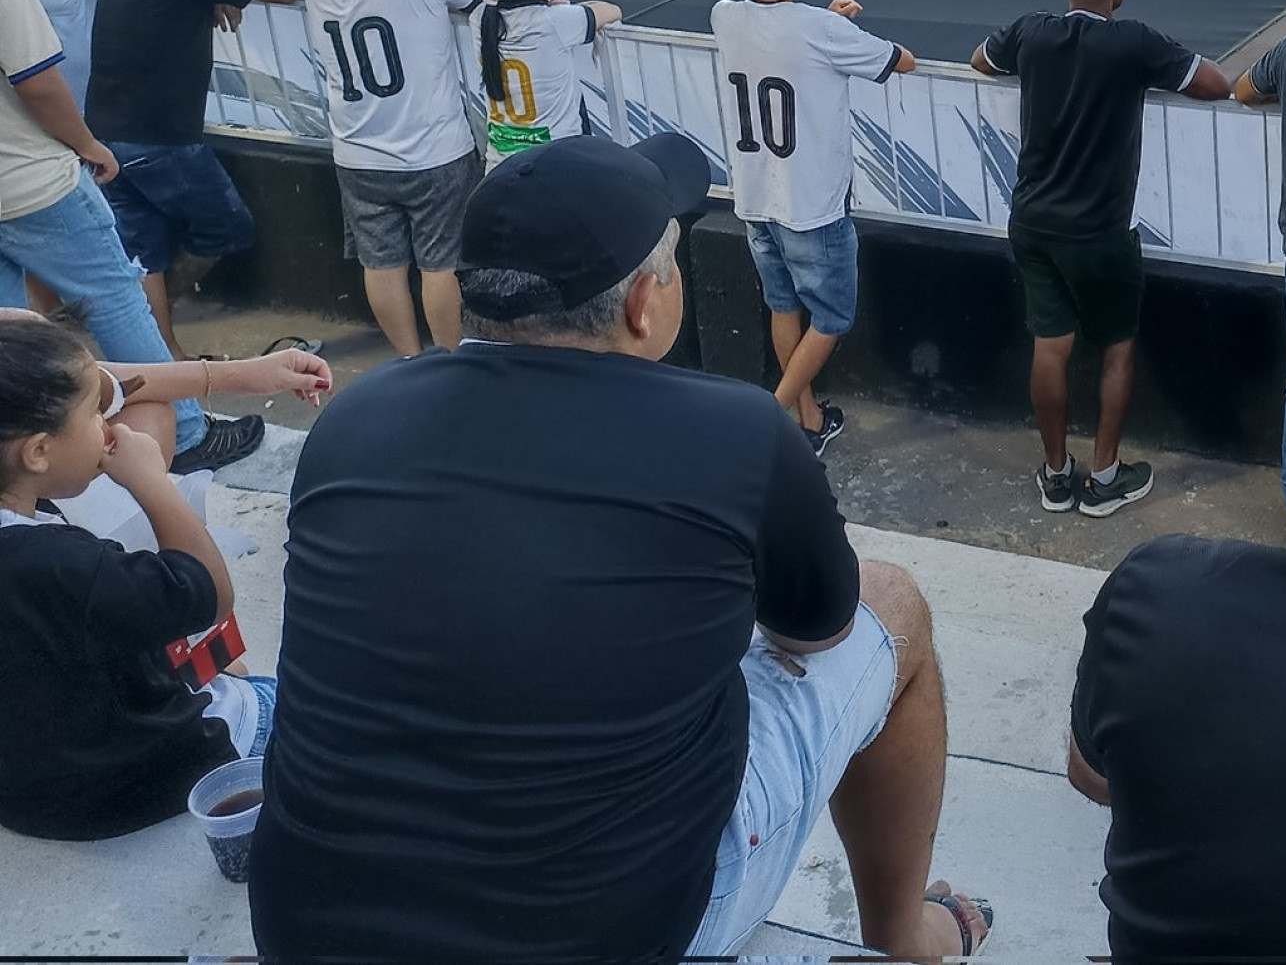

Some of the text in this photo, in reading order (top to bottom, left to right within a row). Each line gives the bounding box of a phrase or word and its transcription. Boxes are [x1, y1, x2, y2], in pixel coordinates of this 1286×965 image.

[323, 16, 405, 103] 10
[489, 57, 538, 125] 0
[728, 71, 796, 160] 10
